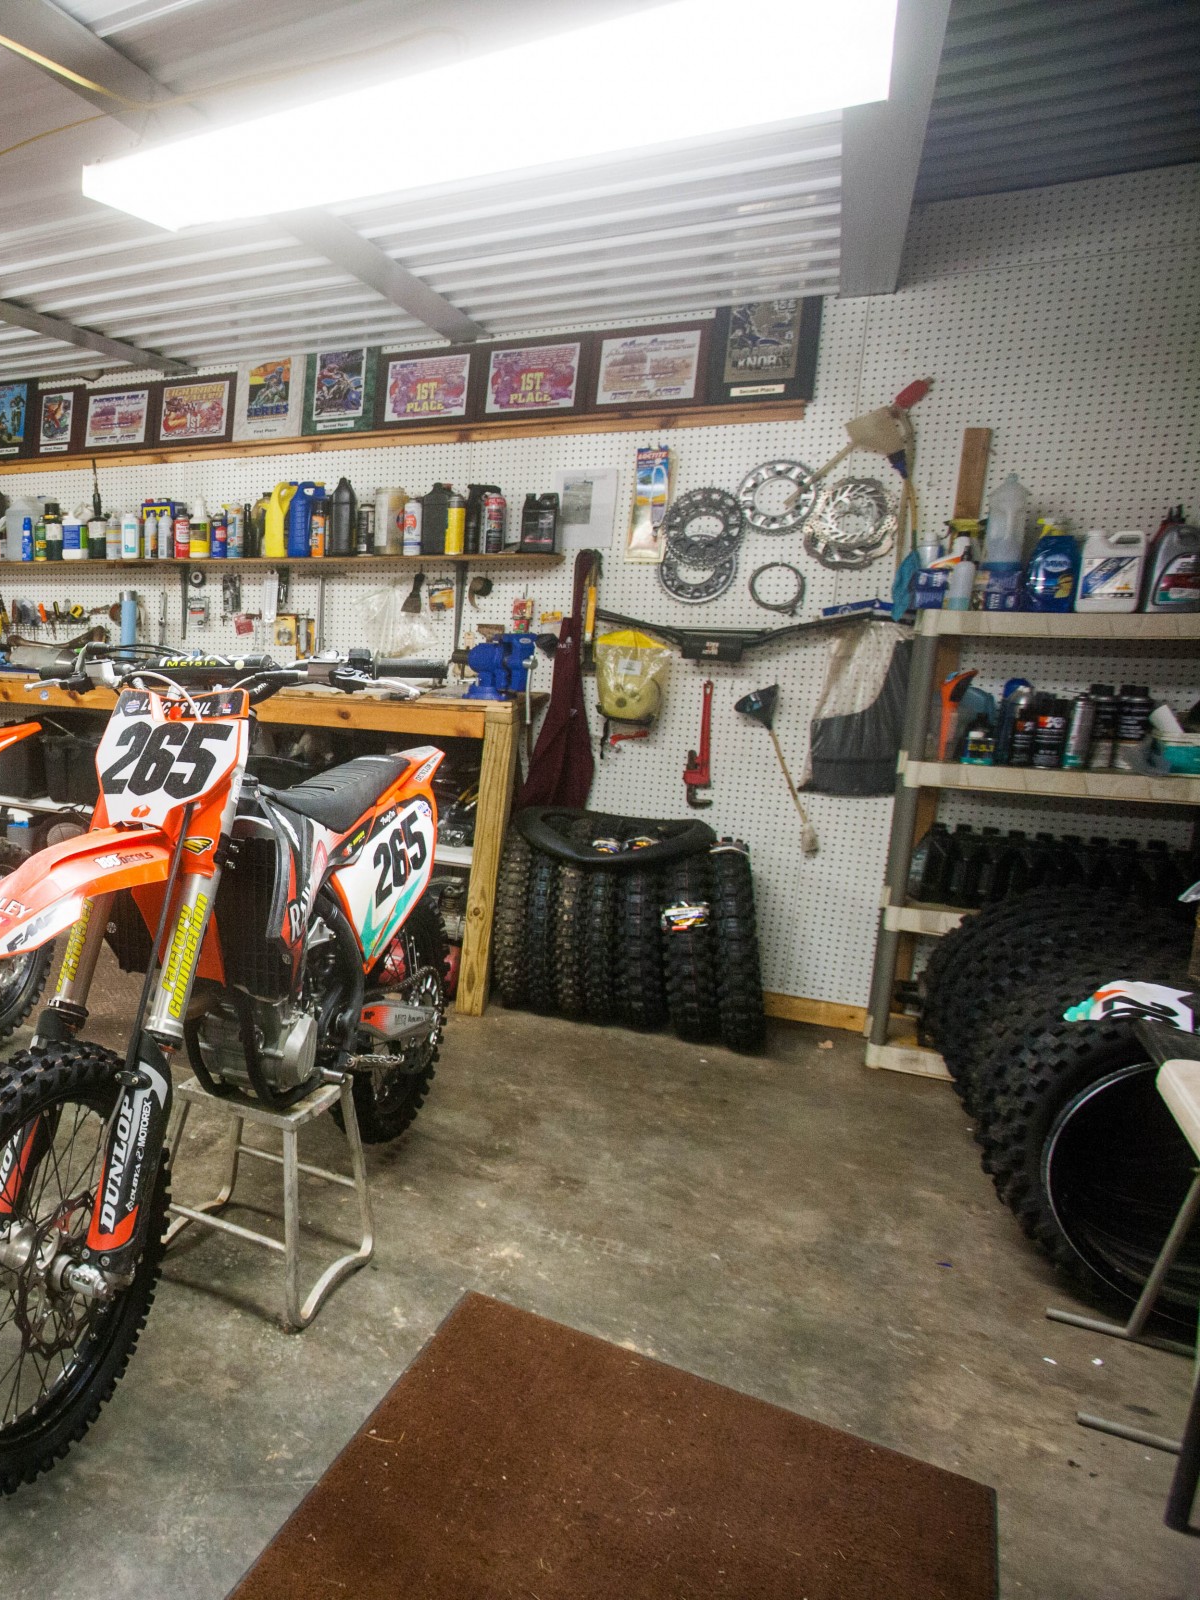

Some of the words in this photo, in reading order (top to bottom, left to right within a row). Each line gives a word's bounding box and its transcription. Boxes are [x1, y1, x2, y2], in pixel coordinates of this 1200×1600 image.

[165, 383, 224, 397] LIGHTNING
[415, 381, 438, 400] 1ST
[520, 371, 545, 391] 1ST
[406, 400, 445, 413] PLACE
[509, 391, 551, 404] PLACE
[246, 403, 289, 417] SERIES
[637, 452, 668, 460] LOCTITE
[166, 659, 217, 667] Metals
[101, 721, 234, 800] 265
[373, 810, 427, 910] 265
[161, 903, 193, 993] Factory
[168, 892, 208, 1019] Connection
[129, 1163, 142, 1203] DUBYA
[137, 1096, 152, 1148] MOTOREX
[101, 1094, 135, 1234] DUNLOP
